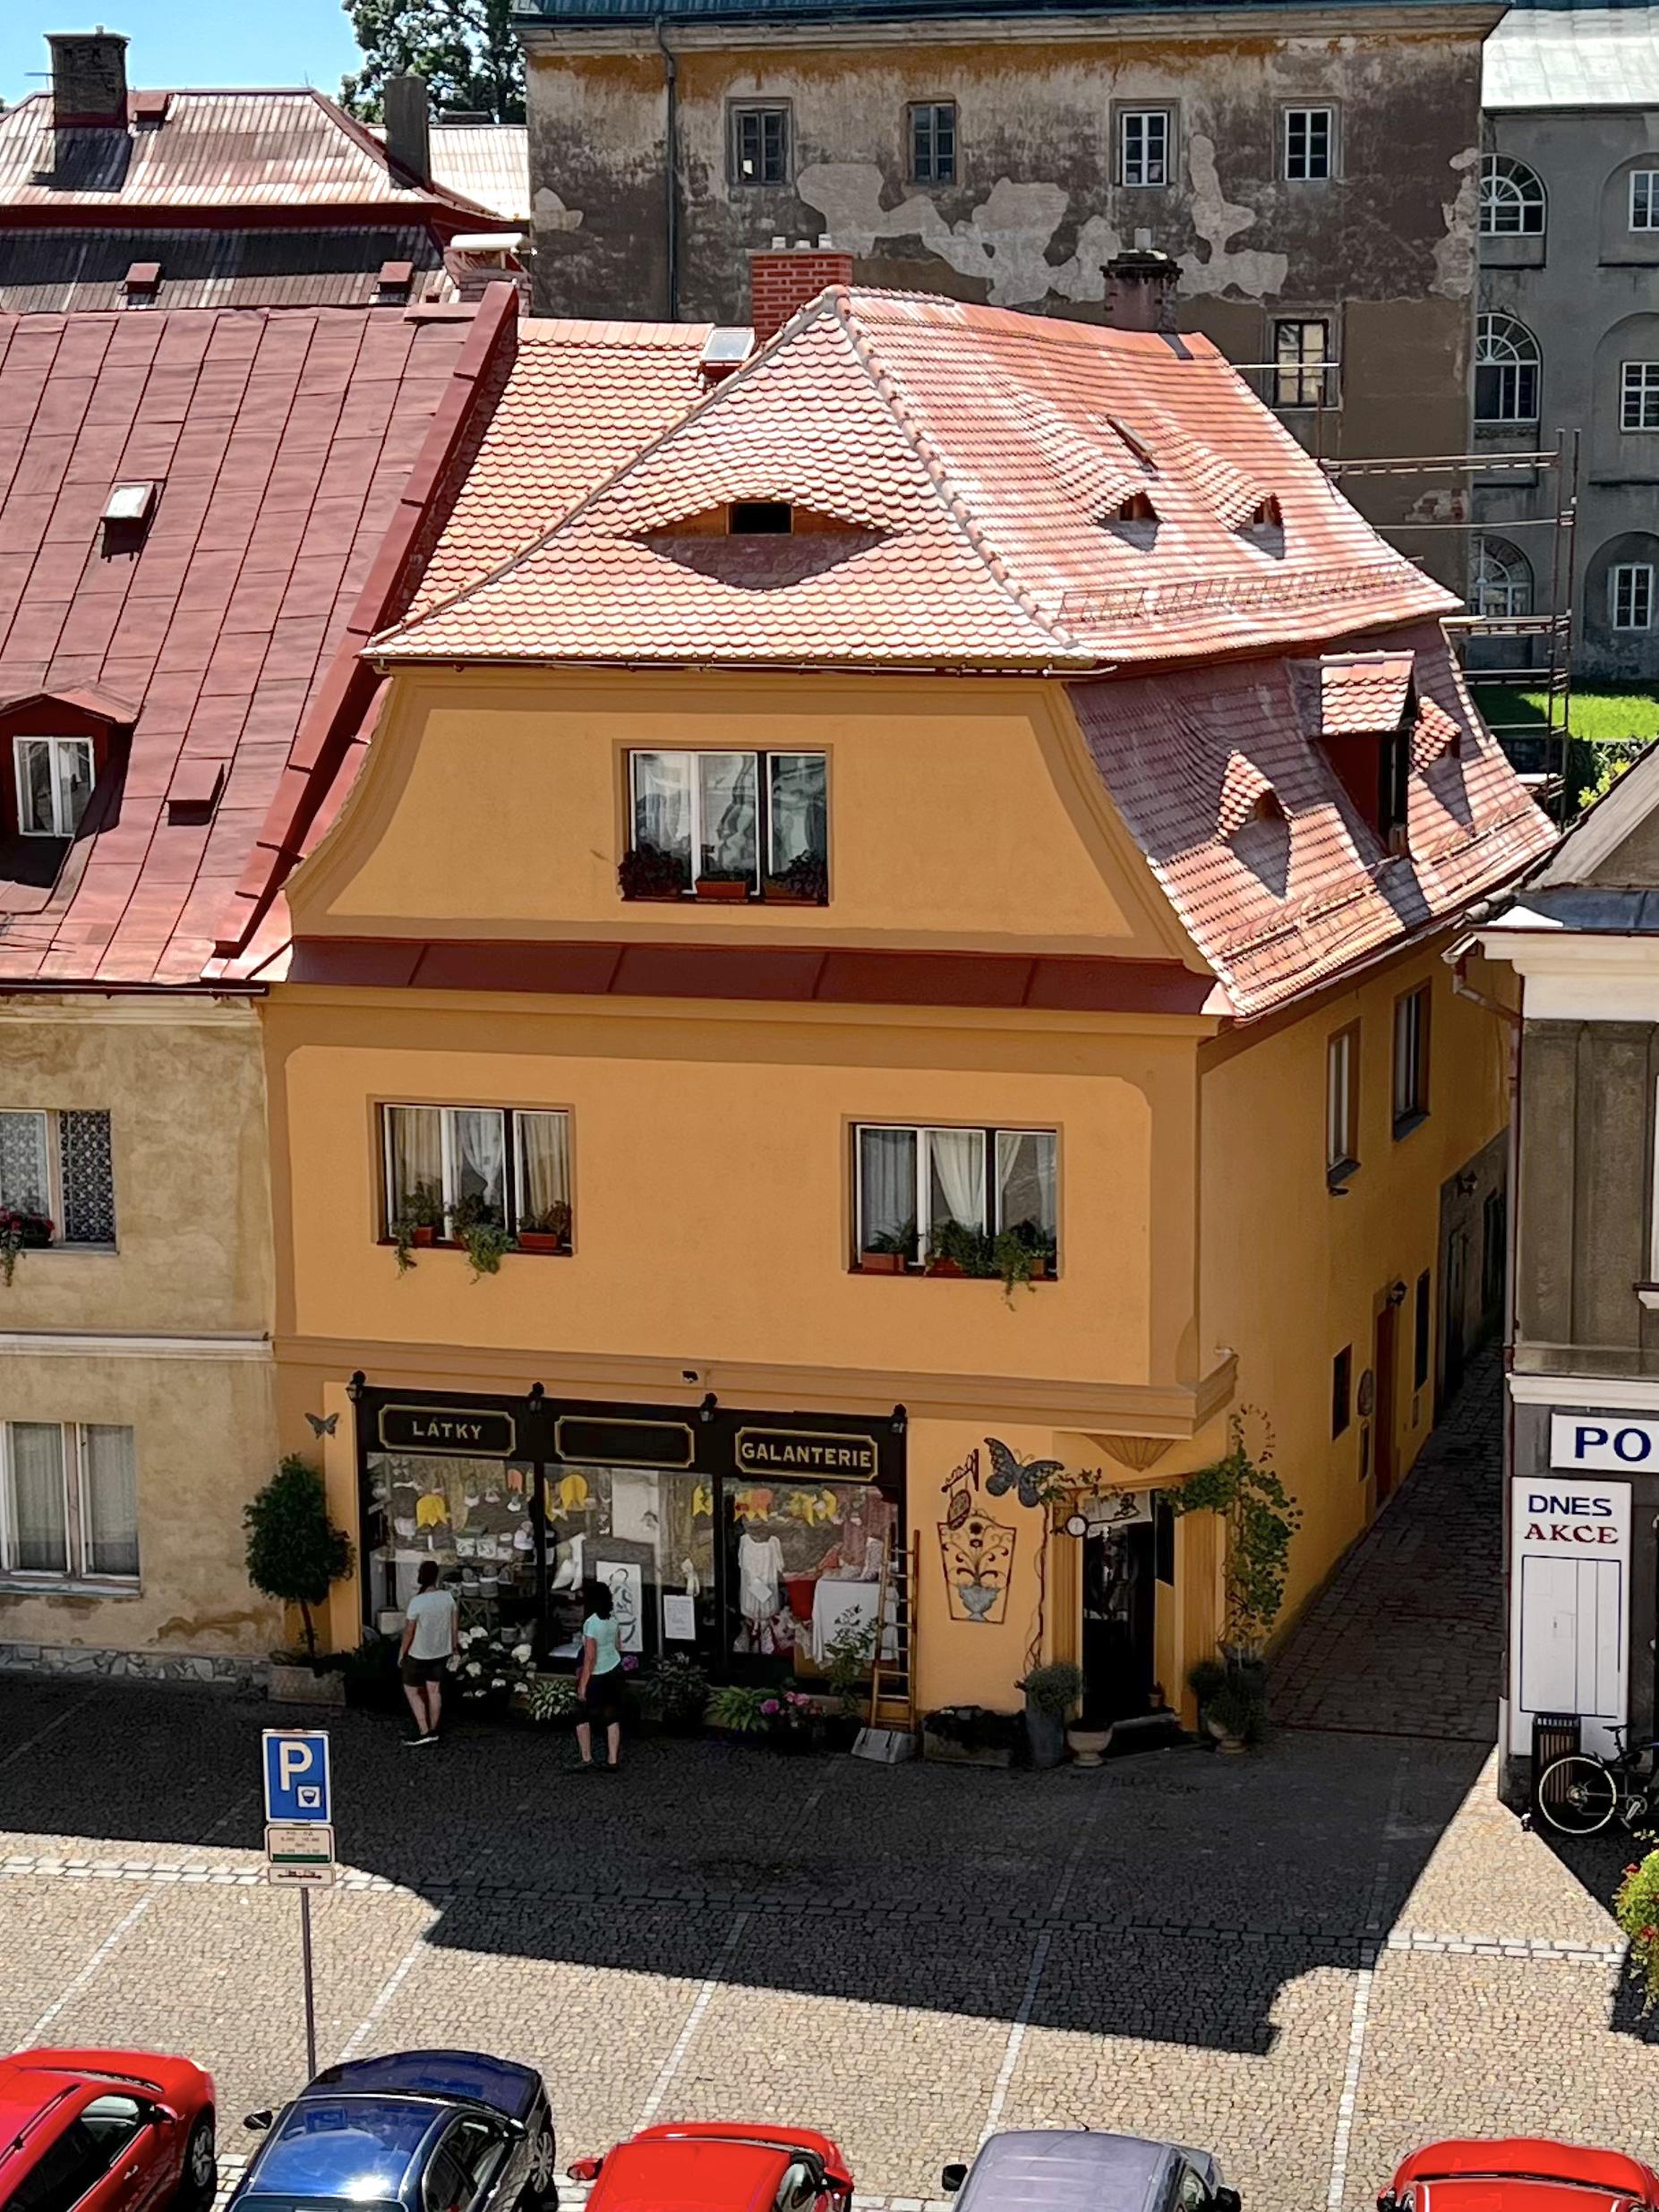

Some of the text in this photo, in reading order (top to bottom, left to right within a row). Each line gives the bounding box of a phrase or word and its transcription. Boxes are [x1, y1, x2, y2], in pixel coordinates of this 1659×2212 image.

[412, 1418, 483, 1439] LÁTKY
[741, 1443, 872, 1468] GALANTERIE
[1528, 1493, 1612, 1516] DNES
[1524, 1523, 1619, 1544] AKCE
[279, 1741, 313, 1791] P
